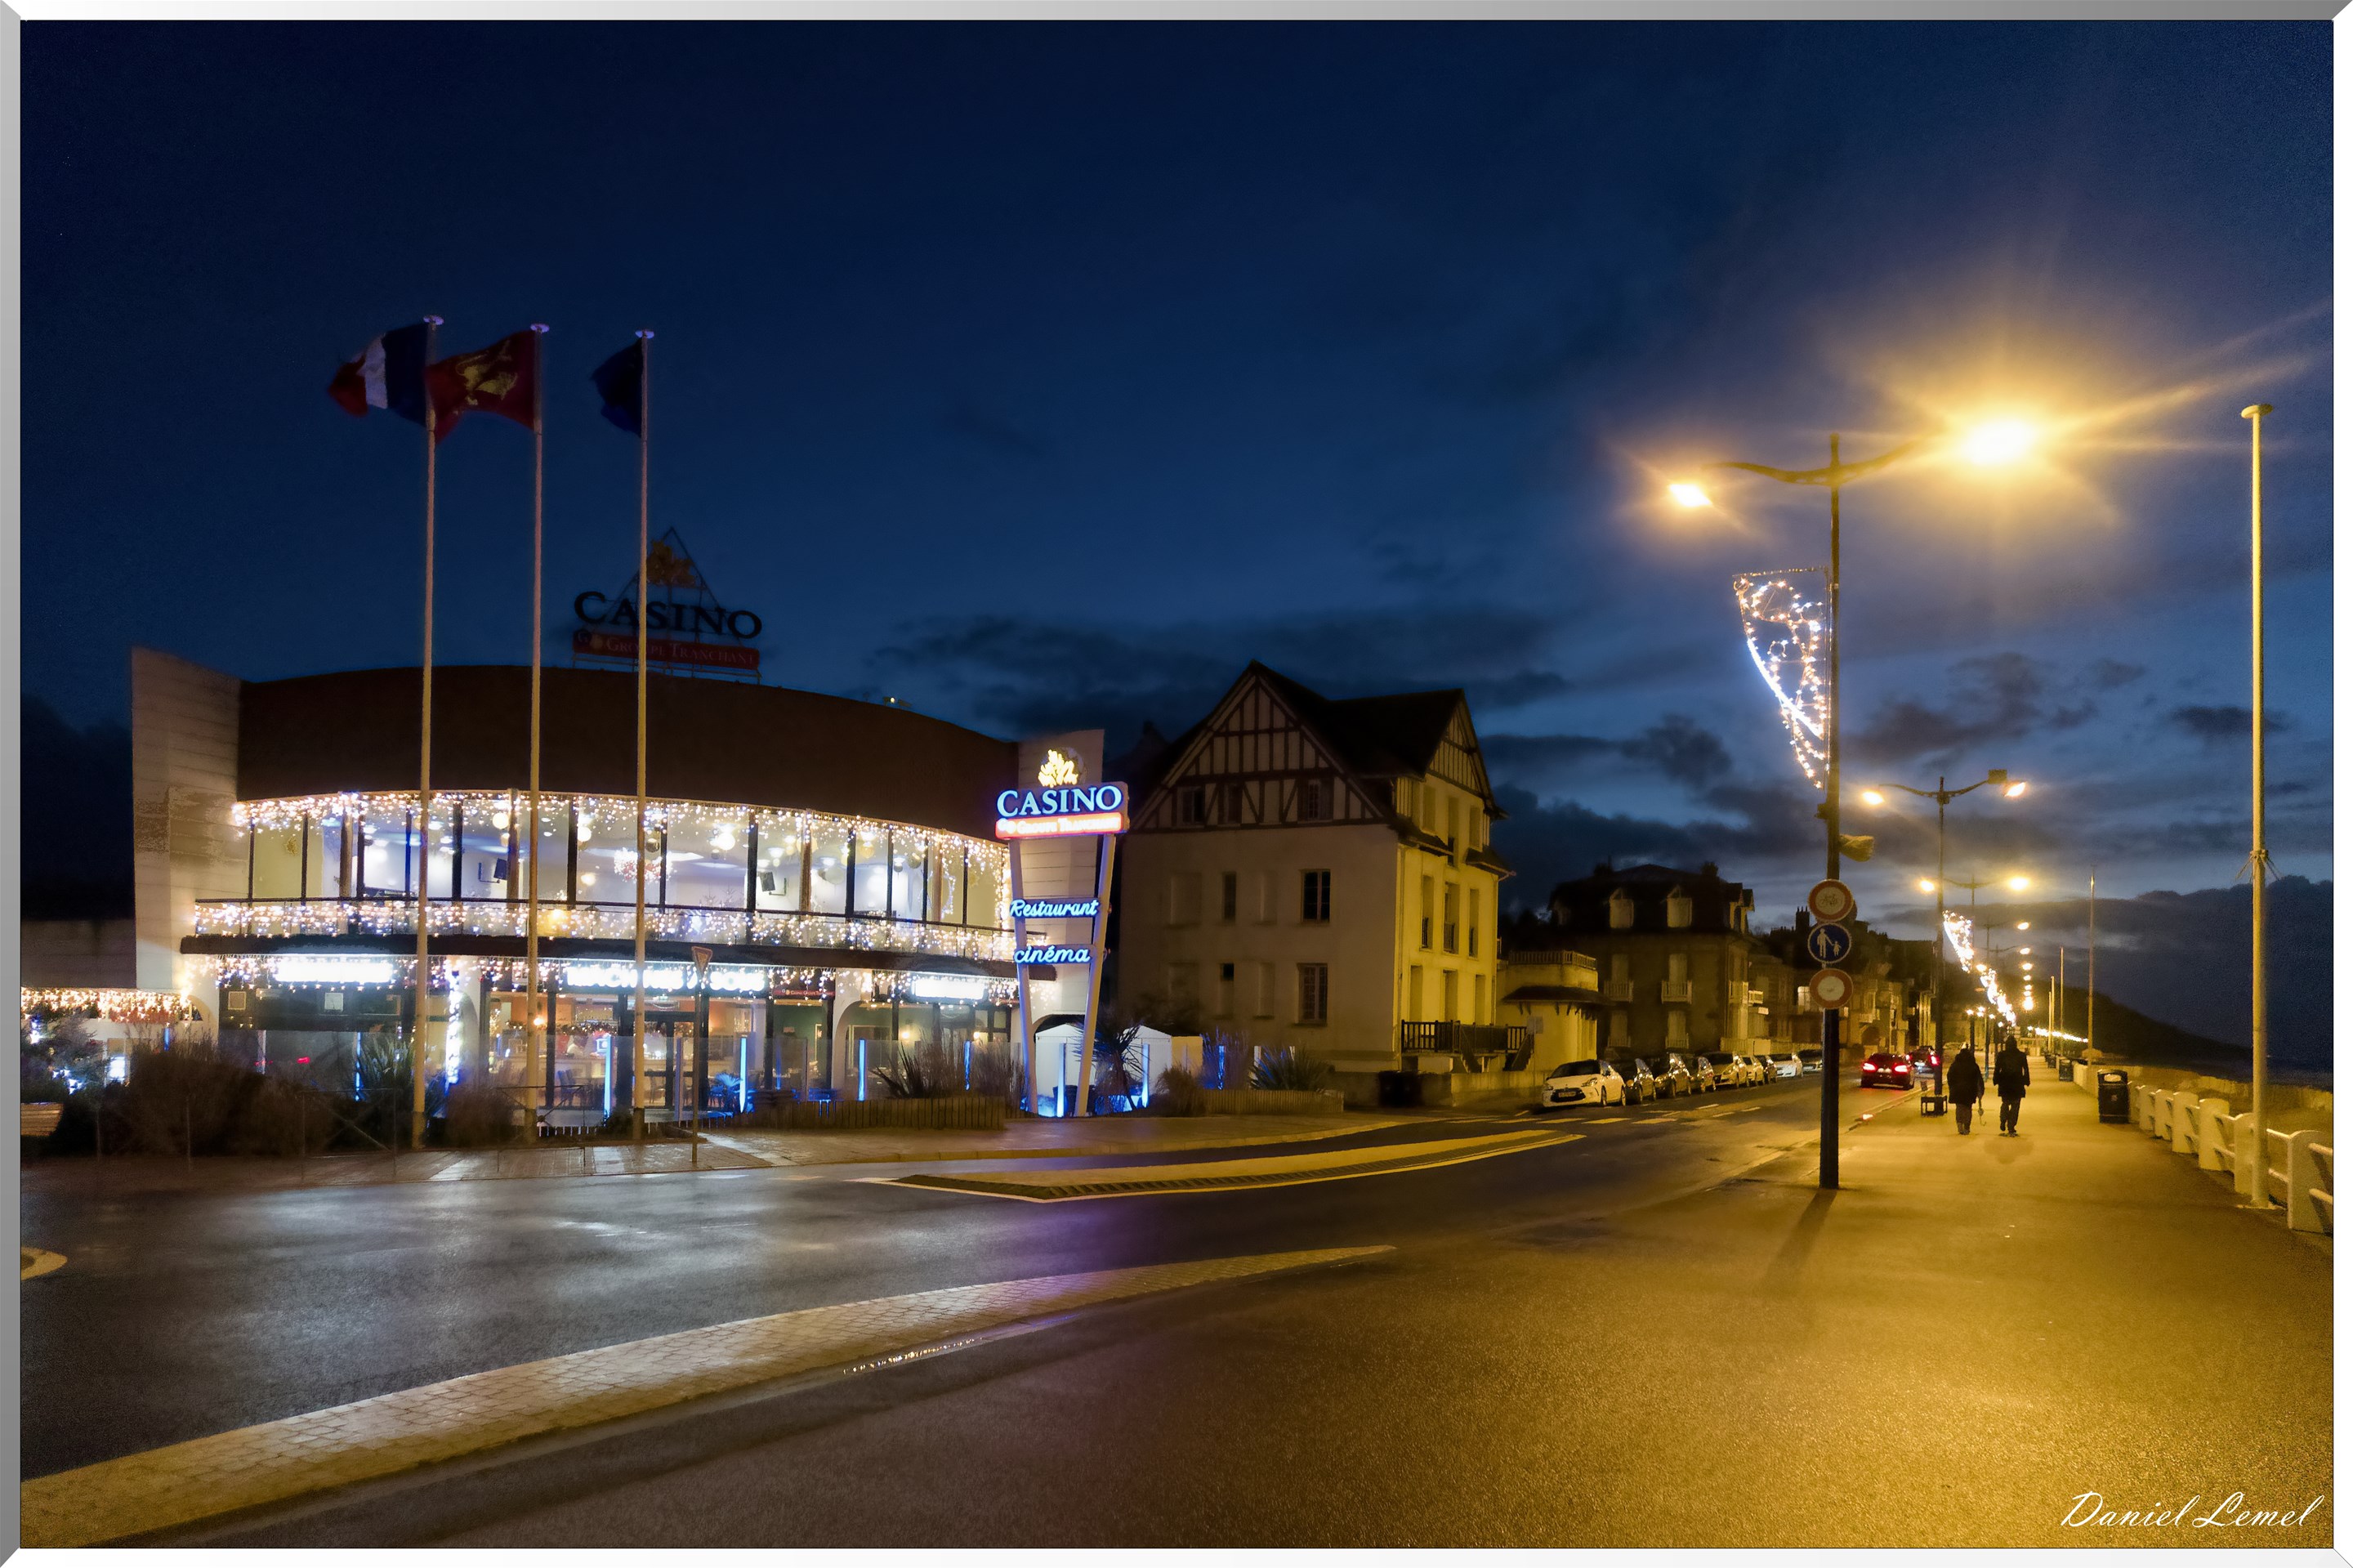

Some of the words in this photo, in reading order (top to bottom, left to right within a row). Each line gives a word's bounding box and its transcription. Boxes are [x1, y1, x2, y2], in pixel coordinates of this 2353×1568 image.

[574, 591, 762, 639] CASINO
[606, 637, 665, 655] GROPE
[997, 785, 1122, 817] CASINO
[1010, 899, 1099, 917] Restaurant
[1014, 945, 1091, 963] cinéma
